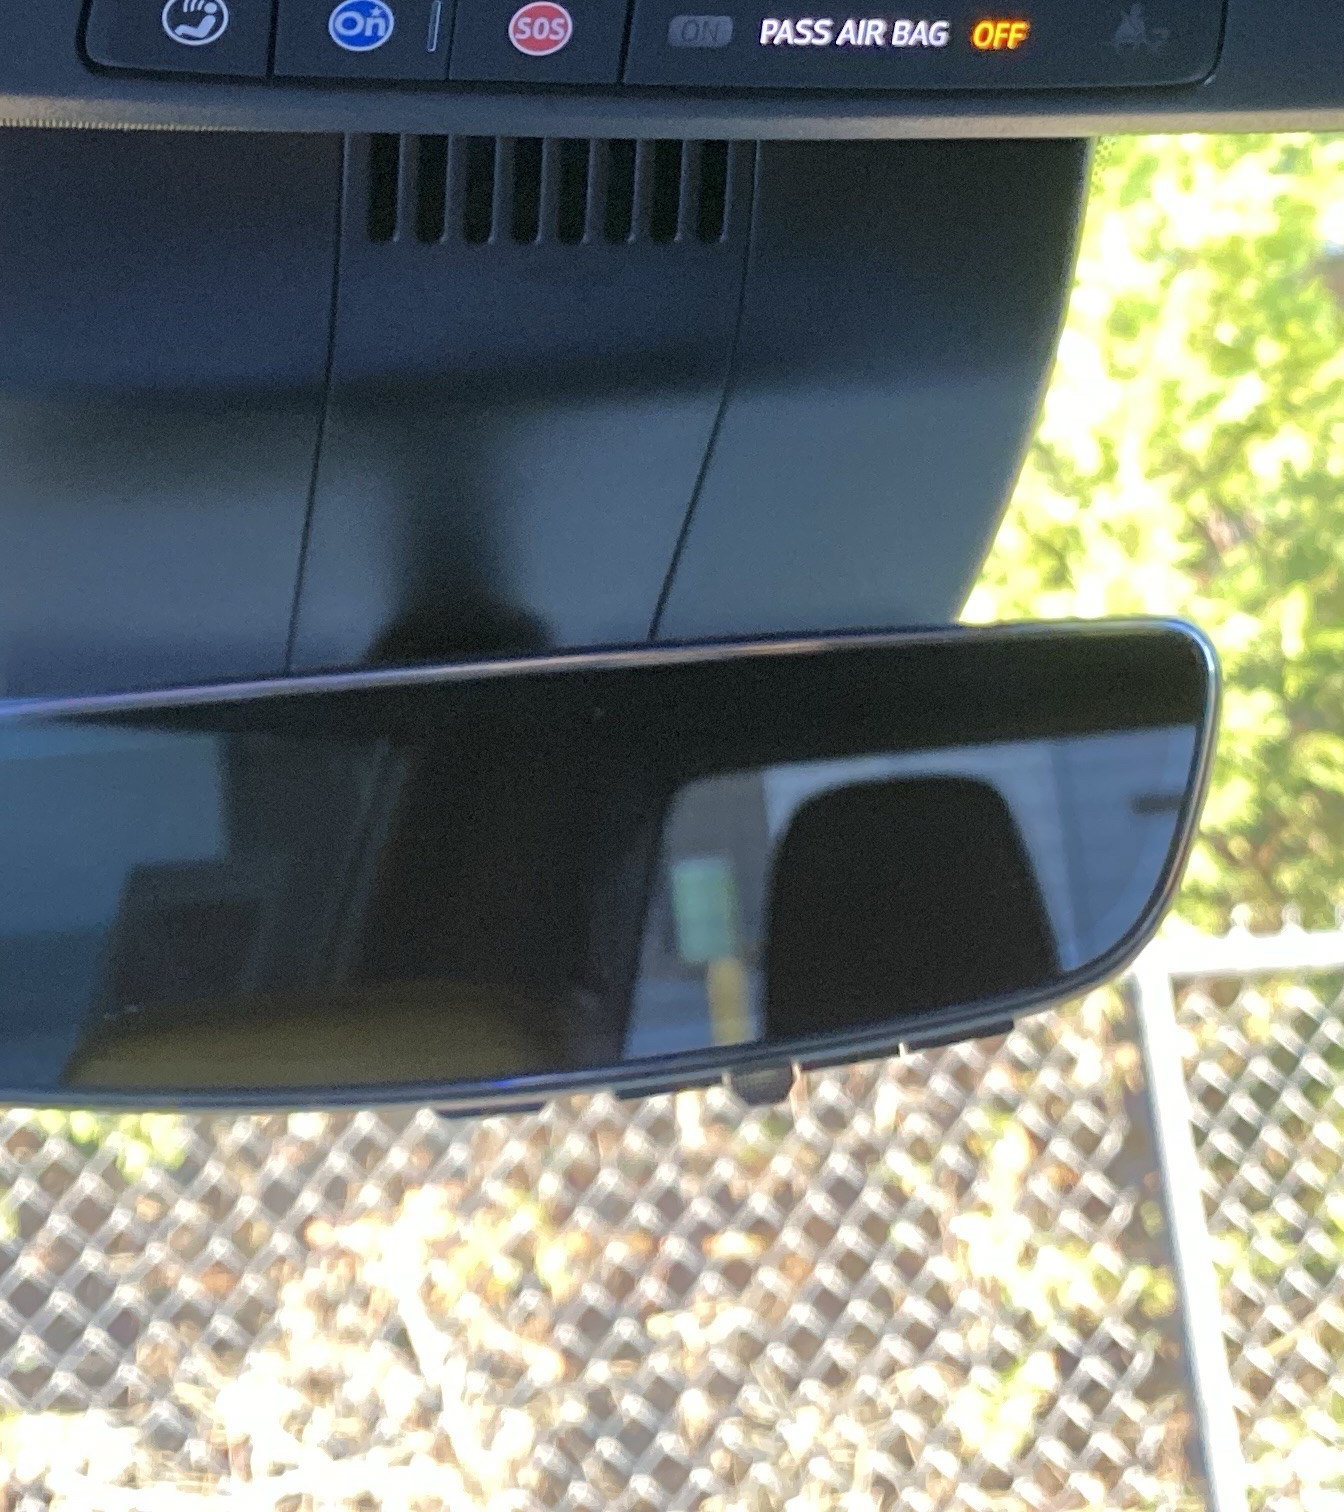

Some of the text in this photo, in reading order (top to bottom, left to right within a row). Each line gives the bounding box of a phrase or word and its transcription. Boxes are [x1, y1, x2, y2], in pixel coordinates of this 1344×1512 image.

[334, 10, 386, 37] On
[513, 16, 566, 40] SOS
[759, 18, 1030, 50] PASS AIR BAG OFF
